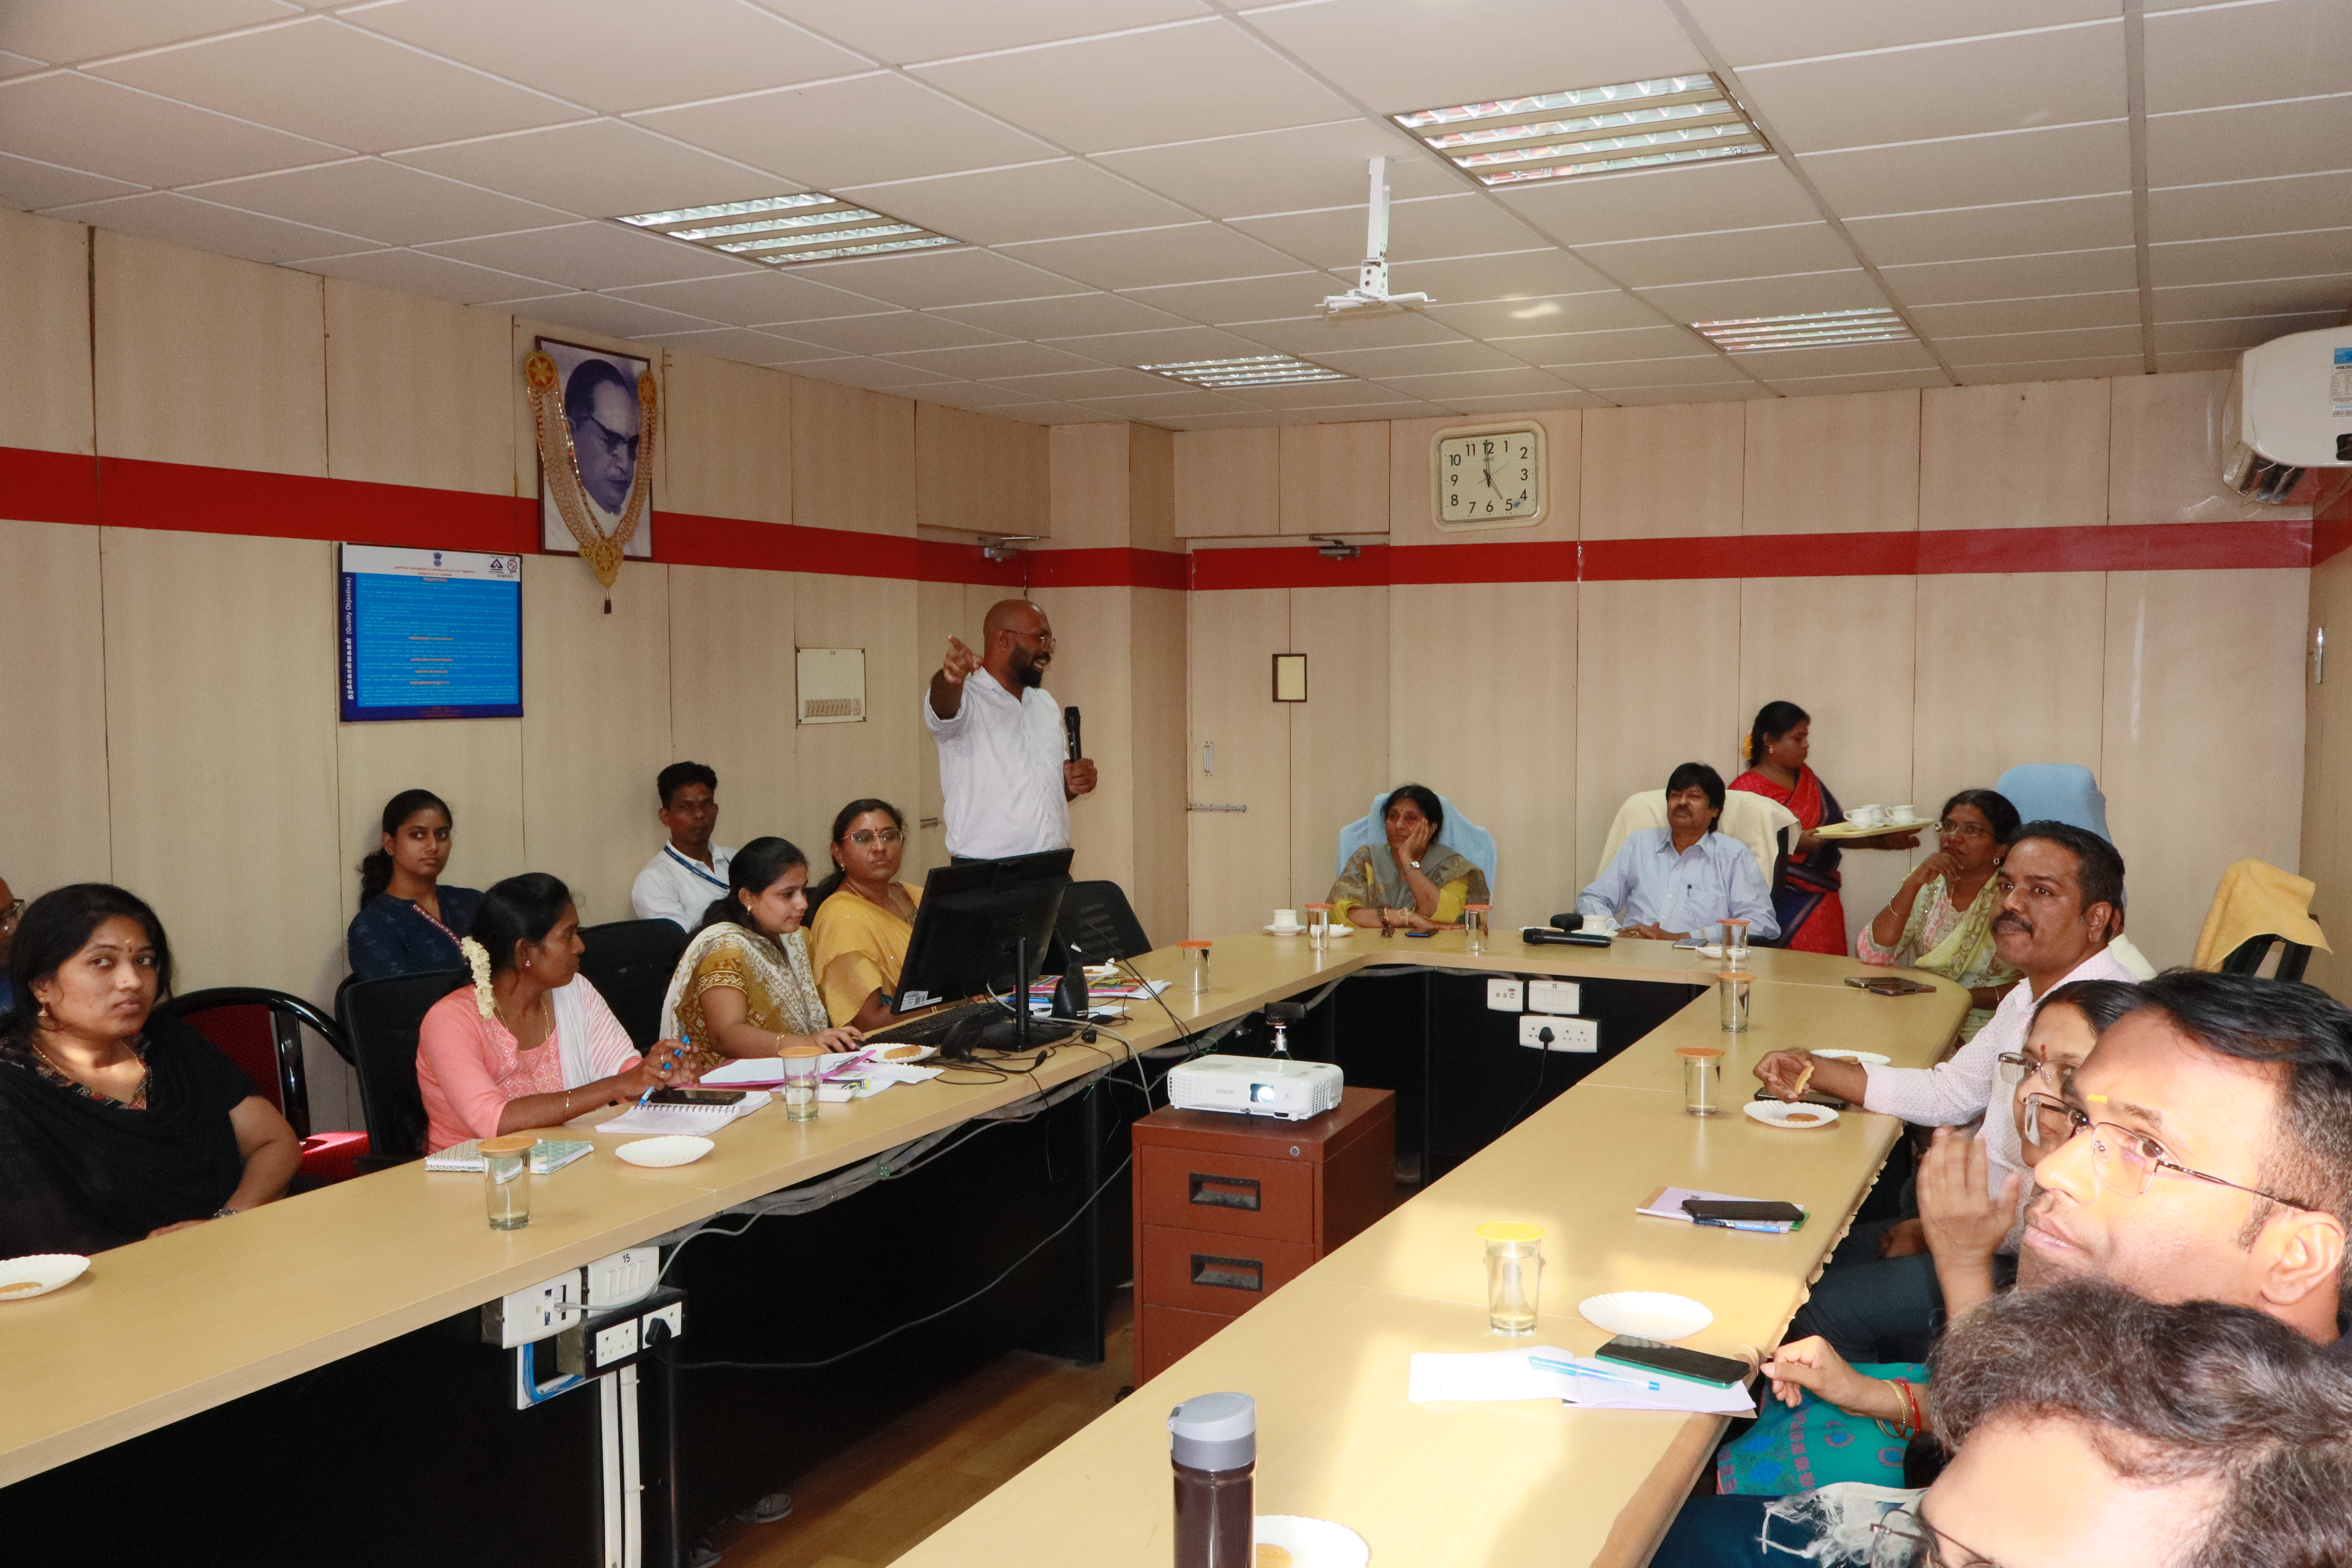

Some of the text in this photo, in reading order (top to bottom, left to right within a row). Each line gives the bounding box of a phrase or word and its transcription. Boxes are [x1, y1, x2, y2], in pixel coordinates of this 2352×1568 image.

[1466, 444, 1475, 456] 11
[1483, 442, 1494, 454] 12
[1504, 441, 1508, 452] 1
[1520, 447, 1528, 459] 2
[1450, 454, 1461, 466] 10
[1451, 474, 1458, 486] 9
[1521, 468, 1528, 481] 3
[1451, 494, 1458, 506] 8
[1519, 489, 1528, 501] 4
[1469, 502, 1476, 514] 7
[1486, 501, 1493, 512] 6
[1505, 499, 1512, 511] 5
[622, 1253, 630, 1263] 15
